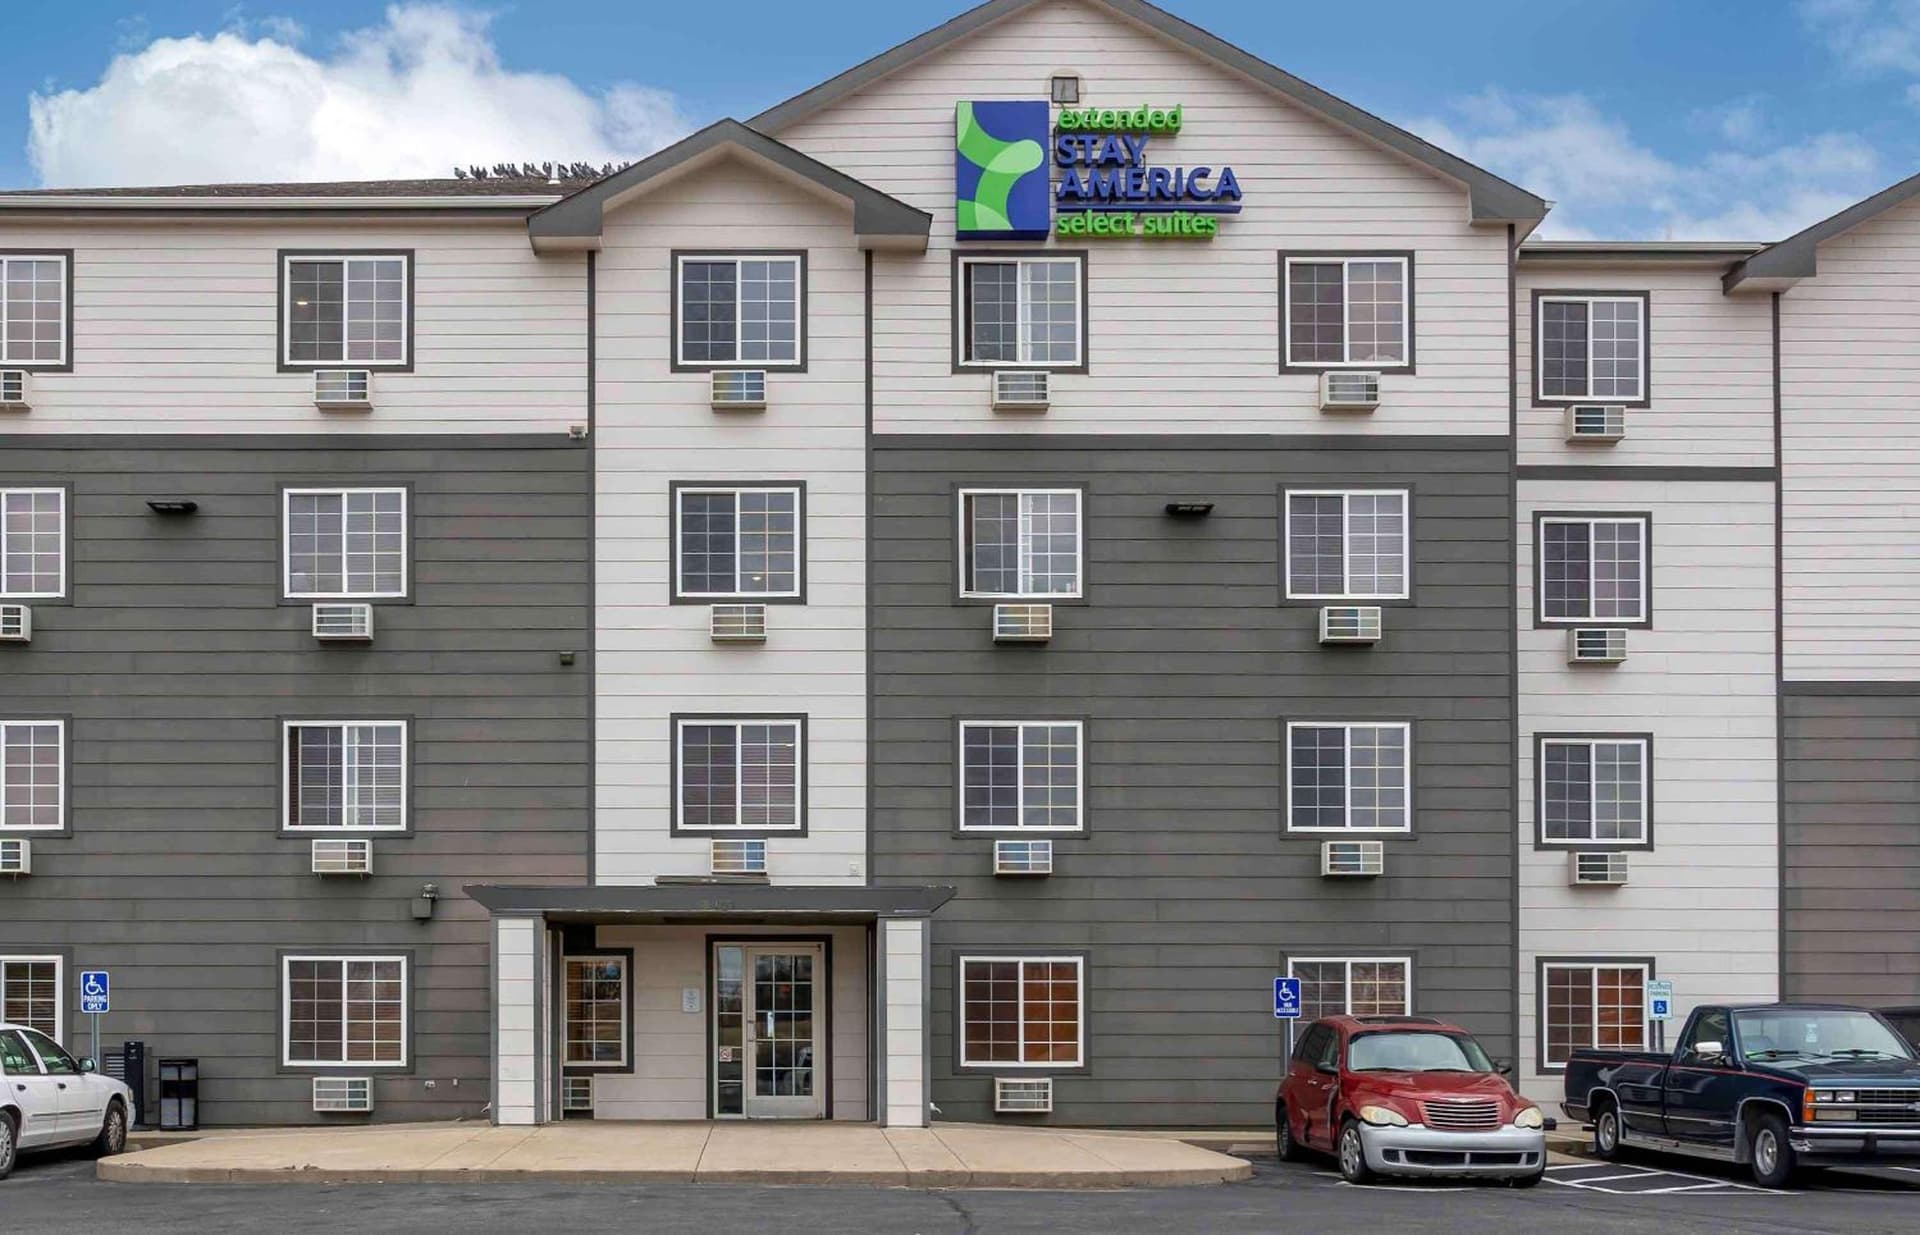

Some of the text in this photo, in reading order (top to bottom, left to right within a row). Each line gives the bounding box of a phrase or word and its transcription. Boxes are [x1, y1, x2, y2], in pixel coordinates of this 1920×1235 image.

[1057, 104, 1182, 131] extended
[1056, 134, 1149, 167] STAY
[1056, 167, 1242, 200] AMERICA
[1057, 209, 1218, 238] select suites
